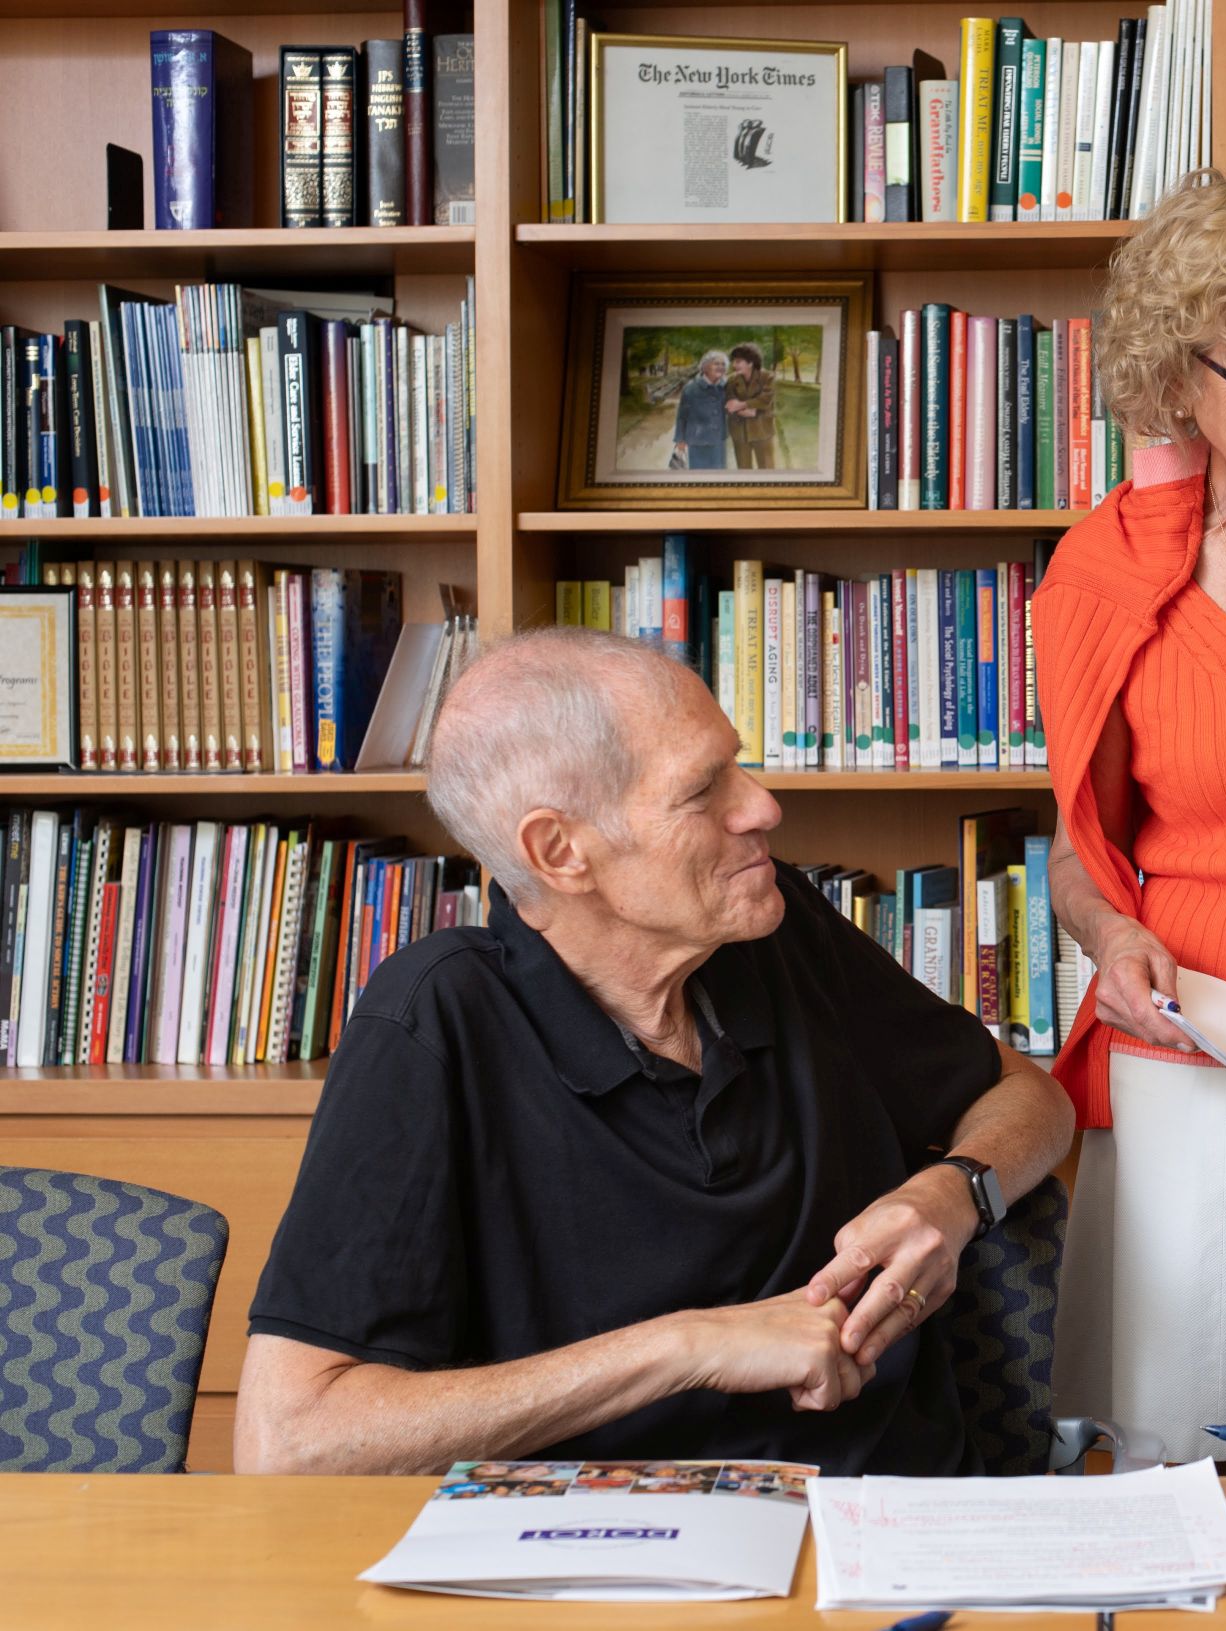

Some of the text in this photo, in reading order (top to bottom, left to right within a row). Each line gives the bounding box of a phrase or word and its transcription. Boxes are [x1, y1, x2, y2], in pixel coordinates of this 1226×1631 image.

[638, 63, 816, 90] The New York Times
[870, 93, 881, 121] TDK
[318, 621, 333, 659] THE
[768, 587, 778, 684] DISRUPT AGING
[944, 625, 954, 638] The
[944, 639, 954, 660] Social
[318, 662, 333, 720] PEOPL
[943, 661, 954, 699] Psychology
[943, 709, 954, 731] Aging
[1029, 896, 1039, 934] SOCIAL
[1038, 897, 1048, 973] AGING AND THE
